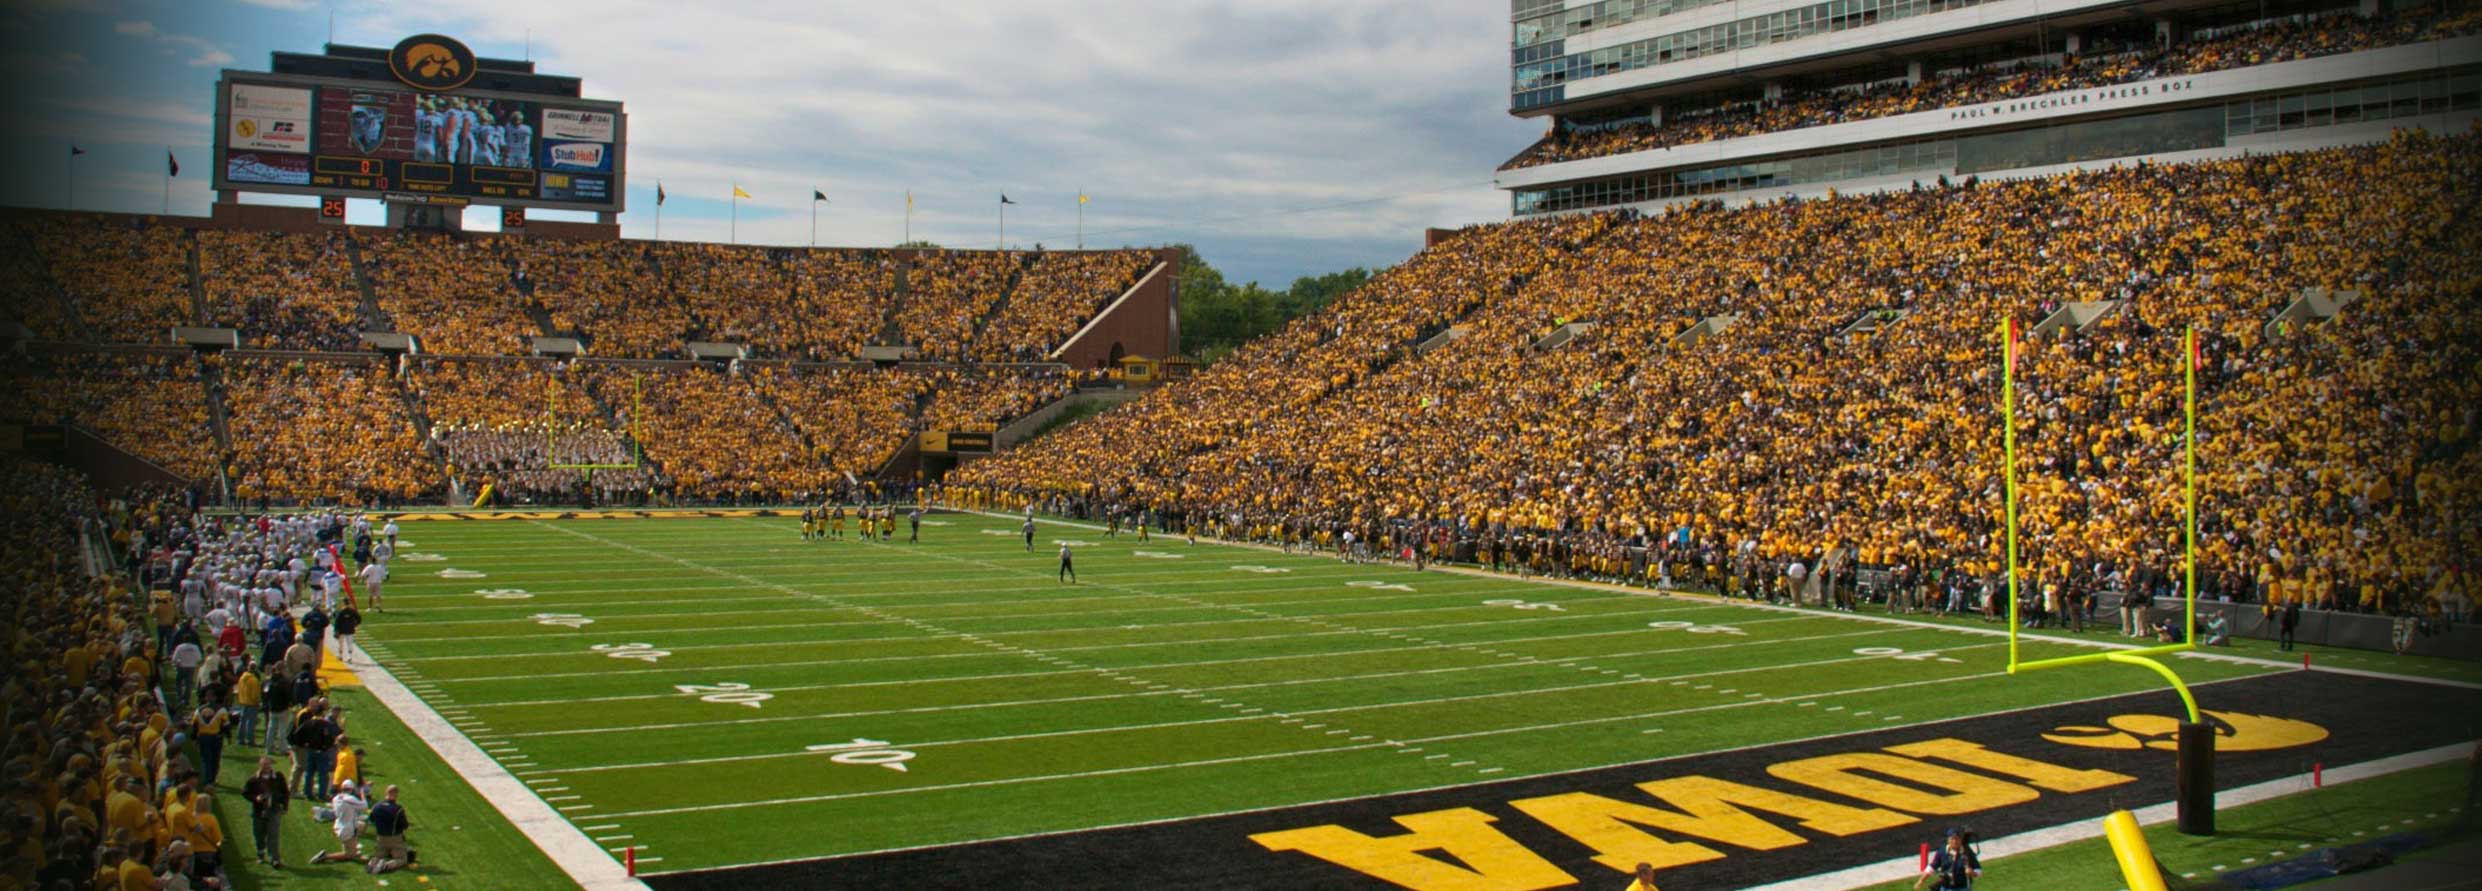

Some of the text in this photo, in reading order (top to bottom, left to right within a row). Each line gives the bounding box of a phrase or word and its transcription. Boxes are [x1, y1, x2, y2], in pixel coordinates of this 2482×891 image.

[1951, 108, 1986, 121] PAUL
[2010, 94, 2089, 114] BRECHLER
[2099, 85, 2150, 101] PRESS
[2161, 79, 2194, 94] BOX
[555, 148, 599, 162] StubHub!
[360, 159, 371, 176] 0
[322, 199, 344, 217] 25
[503, 210, 524, 227] 25
[673, 682, 775, 705] 20
[805, 738, 916, 766] 10
[1248, 737, 2139, 890] IOWA
